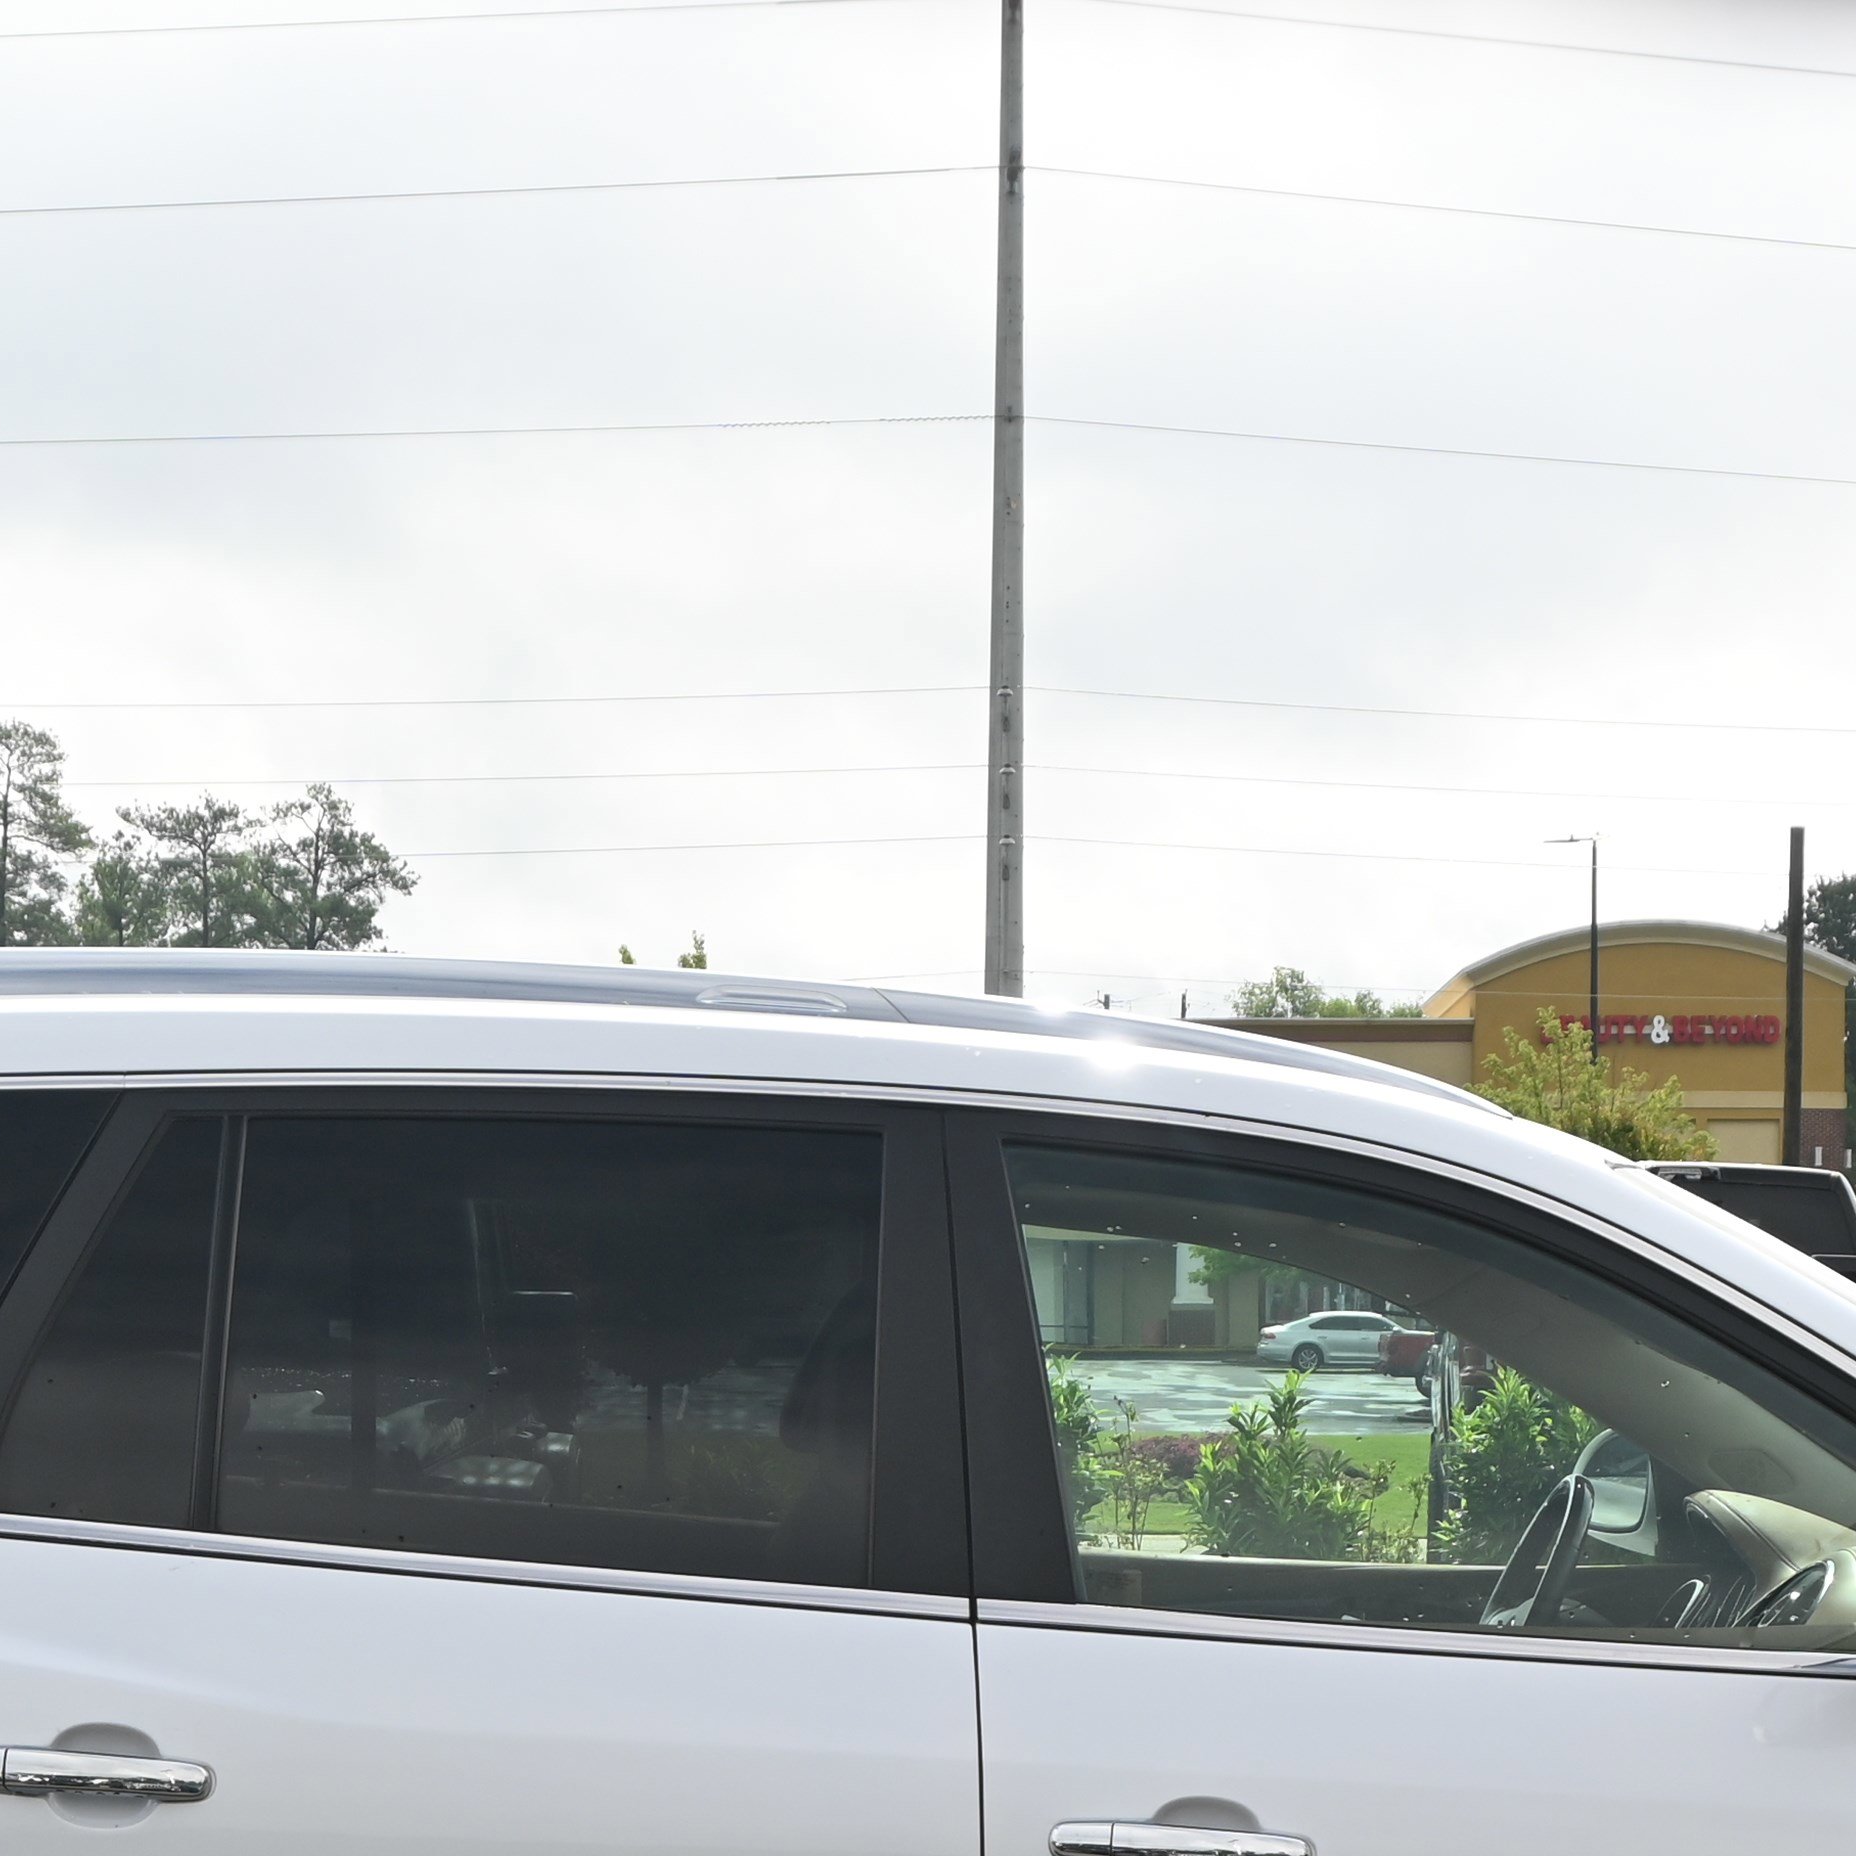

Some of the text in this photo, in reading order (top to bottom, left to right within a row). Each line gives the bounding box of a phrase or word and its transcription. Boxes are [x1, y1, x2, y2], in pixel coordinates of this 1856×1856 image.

[1541, 1014, 1780, 1044] EUTY & BEYOND
